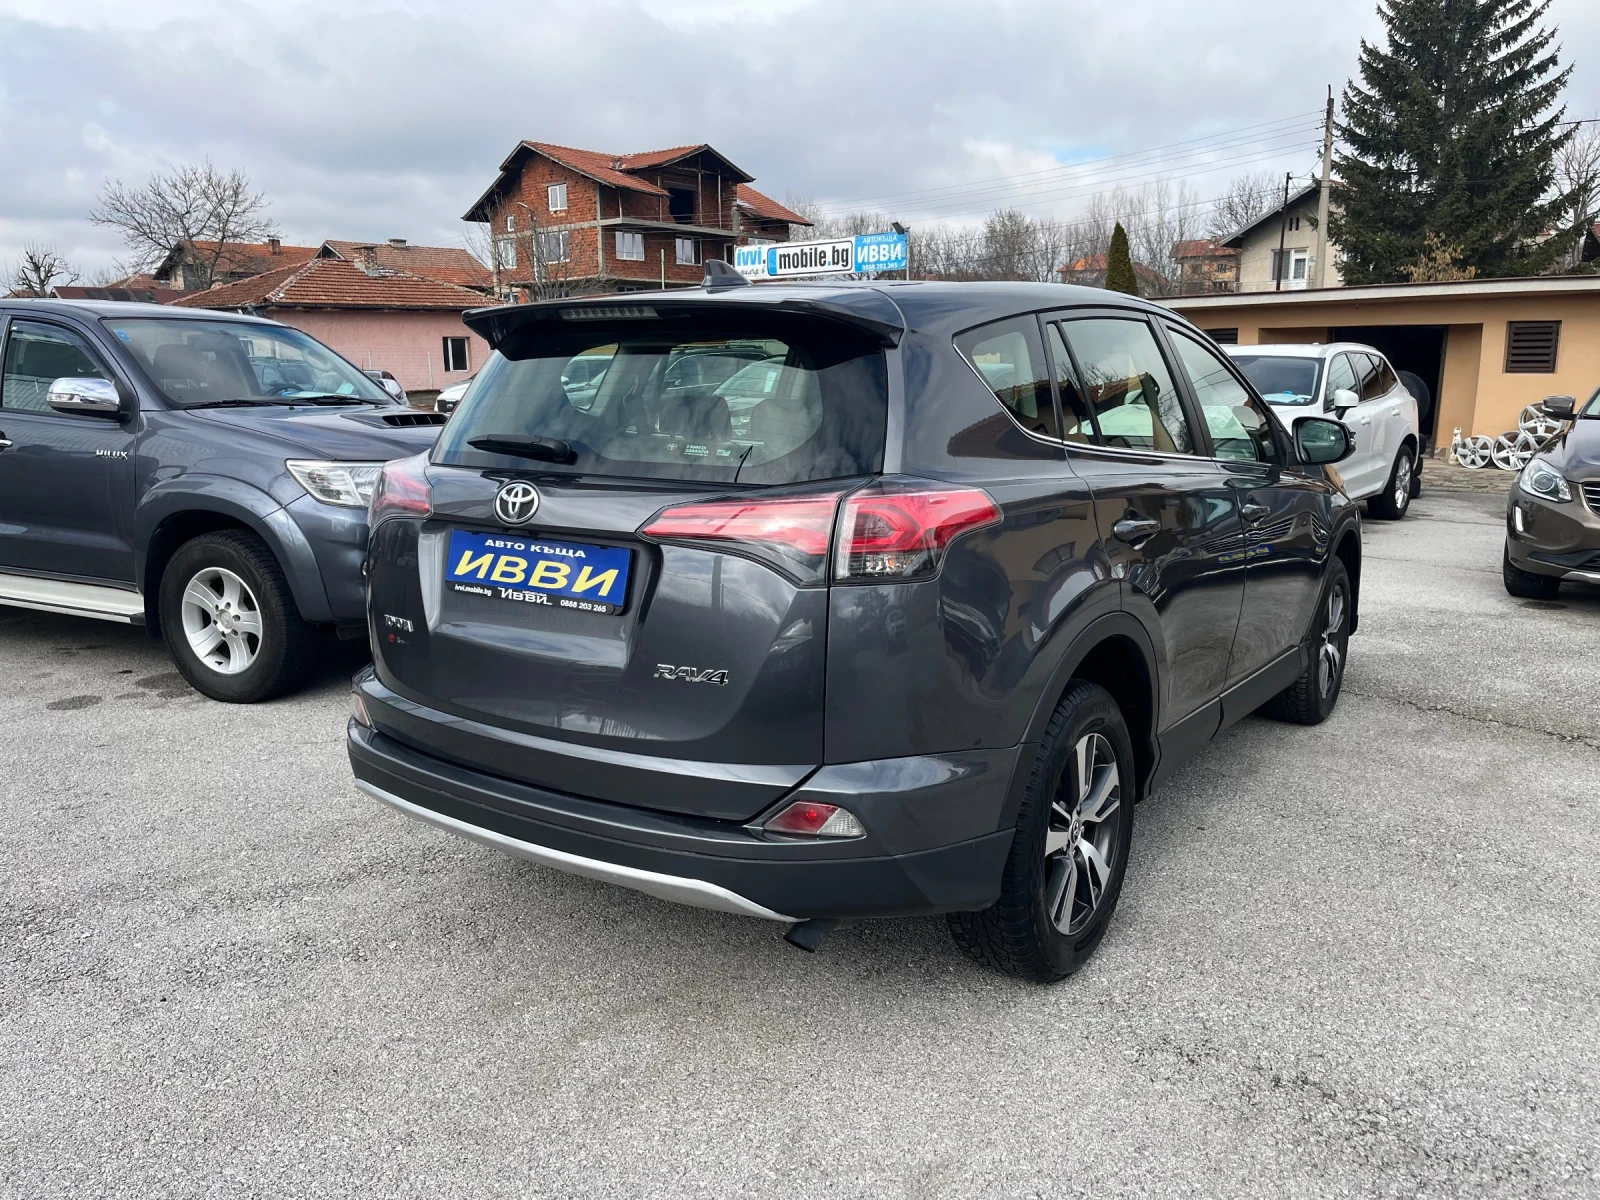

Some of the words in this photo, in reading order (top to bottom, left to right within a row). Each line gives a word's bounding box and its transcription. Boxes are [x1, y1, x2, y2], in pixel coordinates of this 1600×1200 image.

[862, 234, 898, 244] АВТОКЪЩА
[778, 246, 849, 270] mobile.bg
[857, 243, 902, 263] ИВВИ
[95, 449, 128, 461] HILUX
[484, 538, 526, 551] АВТО
[530, 544, 587, 559] КЪЩА
[454, 550, 619, 597] ИВВИ
[454, 583, 492, 597] ivvi.mobile.bg
[497, 586, 553, 606] ИВВИ
[560, 599, 578, 608] 0888
[578, 602, 592, 610] 203
[593, 604, 607, 613] 265
[653, 663, 729, 686] RAV4
